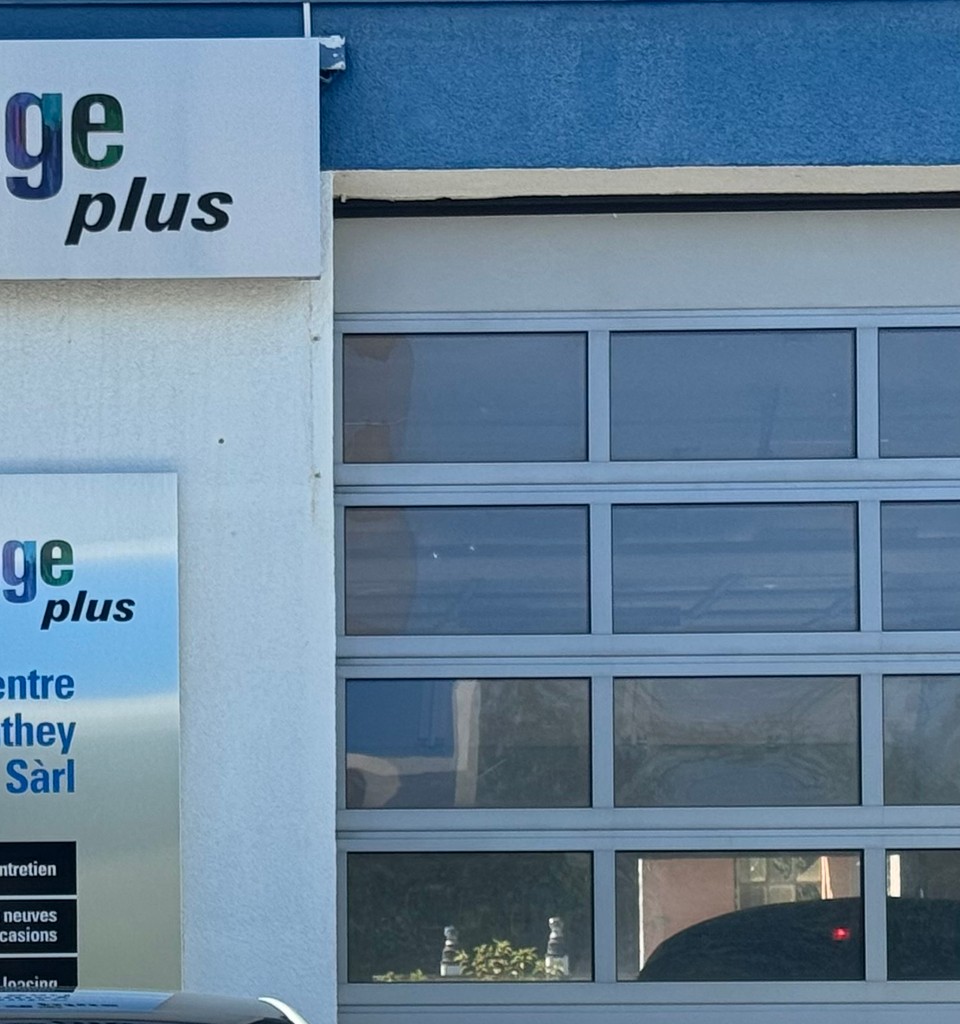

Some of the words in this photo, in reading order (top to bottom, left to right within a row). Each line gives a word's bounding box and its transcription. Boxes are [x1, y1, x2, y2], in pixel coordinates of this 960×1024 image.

[64, 177, 234, 245] plus
[40, 590, 136, 630] plus
[6, 759, 76, 794] Sàrl
[3, 910, 58, 923] neuves
